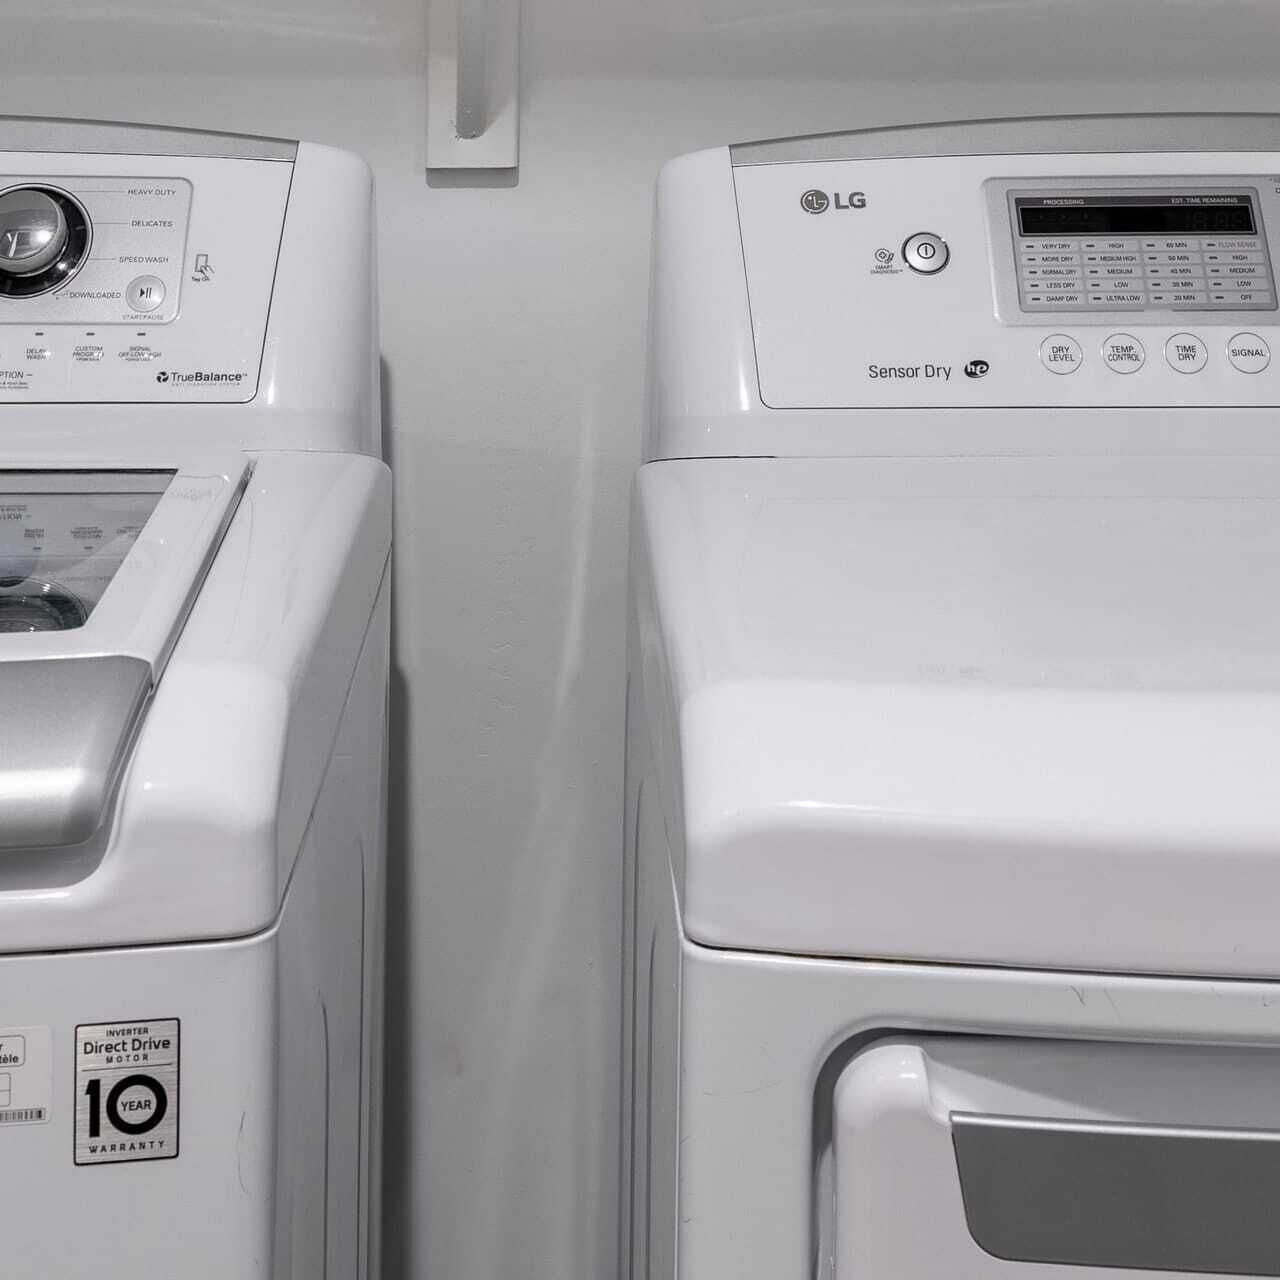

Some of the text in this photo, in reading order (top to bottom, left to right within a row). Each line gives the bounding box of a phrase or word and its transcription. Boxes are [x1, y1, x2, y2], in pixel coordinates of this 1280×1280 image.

[1052, 345, 1070, 354] DRY
[1111, 345, 1137, 354] TEMP.
[1176, 345, 1197, 353] TIME
[1231, 349, 1265, 357] SIGNAL
[1048, 354, 1075, 362] LEVEL
[1108, 353, 1141, 362] CONTROL
[1178, 353, 1196, 361] DRY
[868, 364, 952, 380] Sensor Dry
[106, 1027, 149, 1037] INVERTER
[83, 1037, 171, 1055] Direct Drive
[106, 1054, 149, 1064] MOTOR
[85, 1074, 168, 1138] 10
[120, 1100, 152, 1112] YEAR
[88, 1140, 165, 1154] WARRANTY
